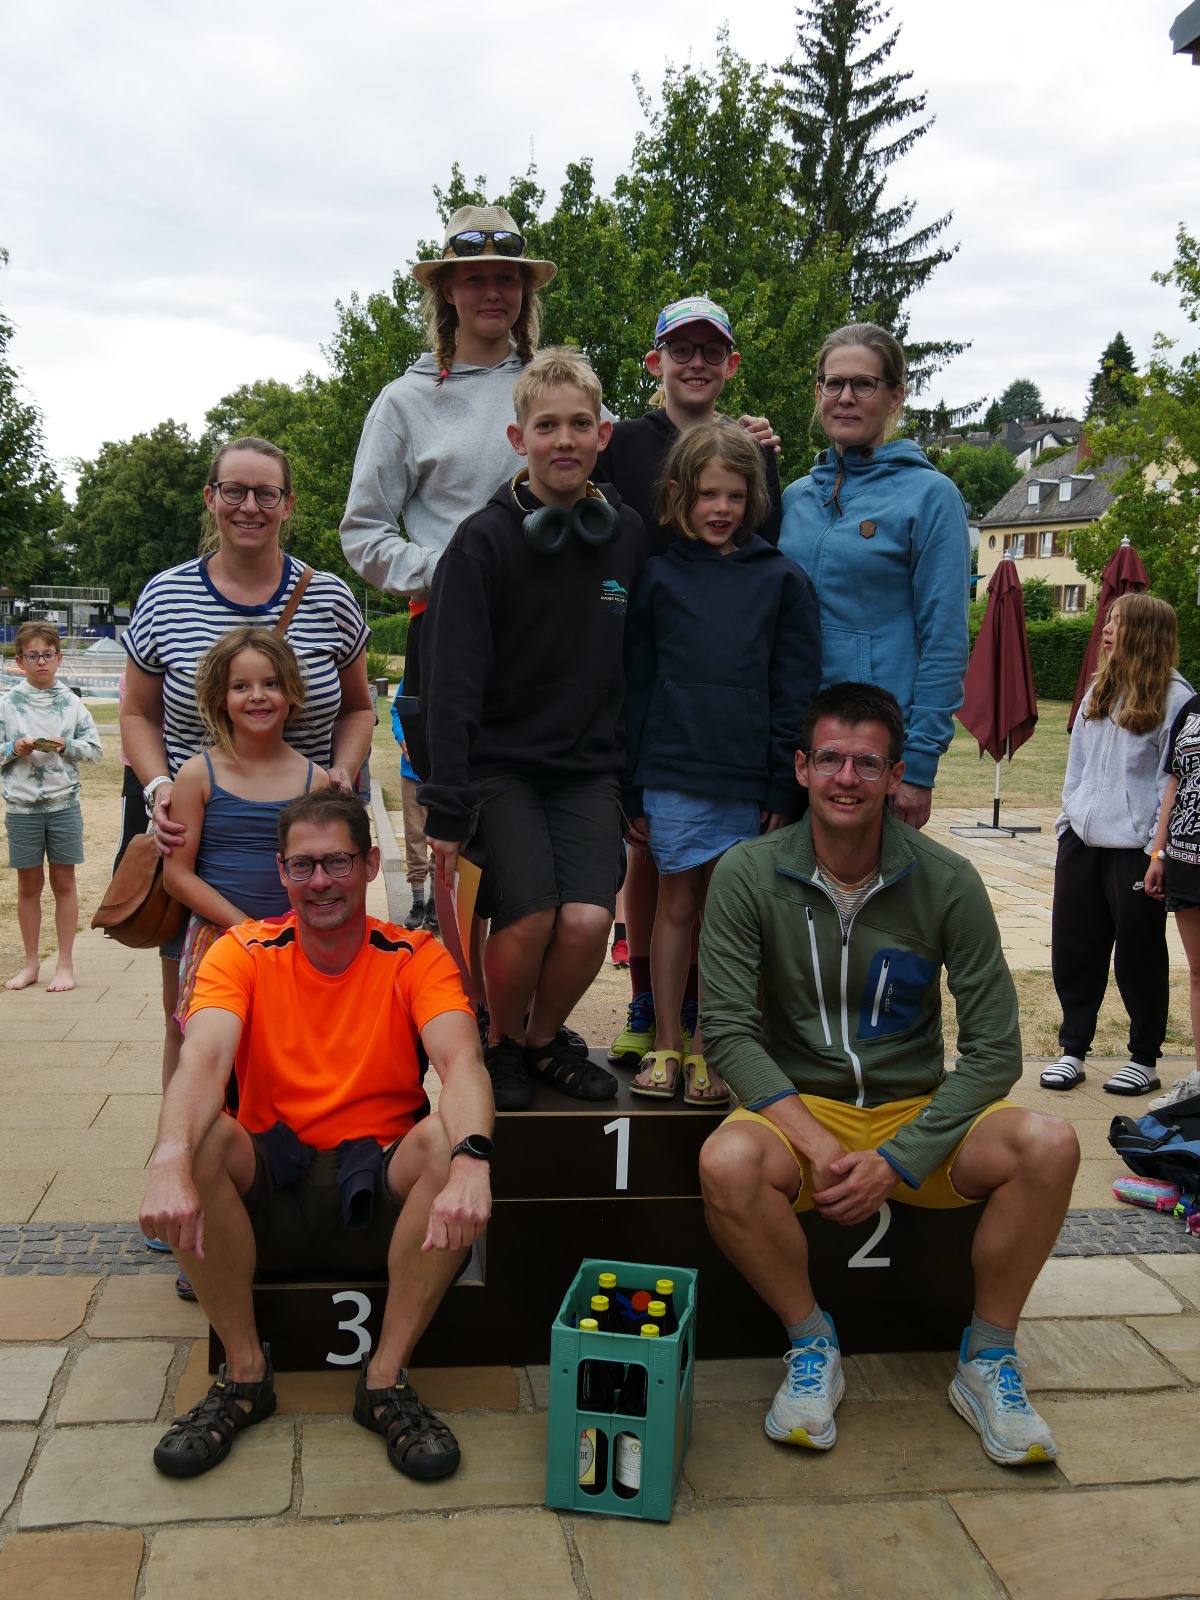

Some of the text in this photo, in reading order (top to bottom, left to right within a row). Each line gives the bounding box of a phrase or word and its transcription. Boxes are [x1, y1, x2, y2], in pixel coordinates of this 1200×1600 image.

[603, 1117, 630, 1190] 1
[847, 1199, 892, 1268] 2
[325, 1290, 372, 1365] 3
